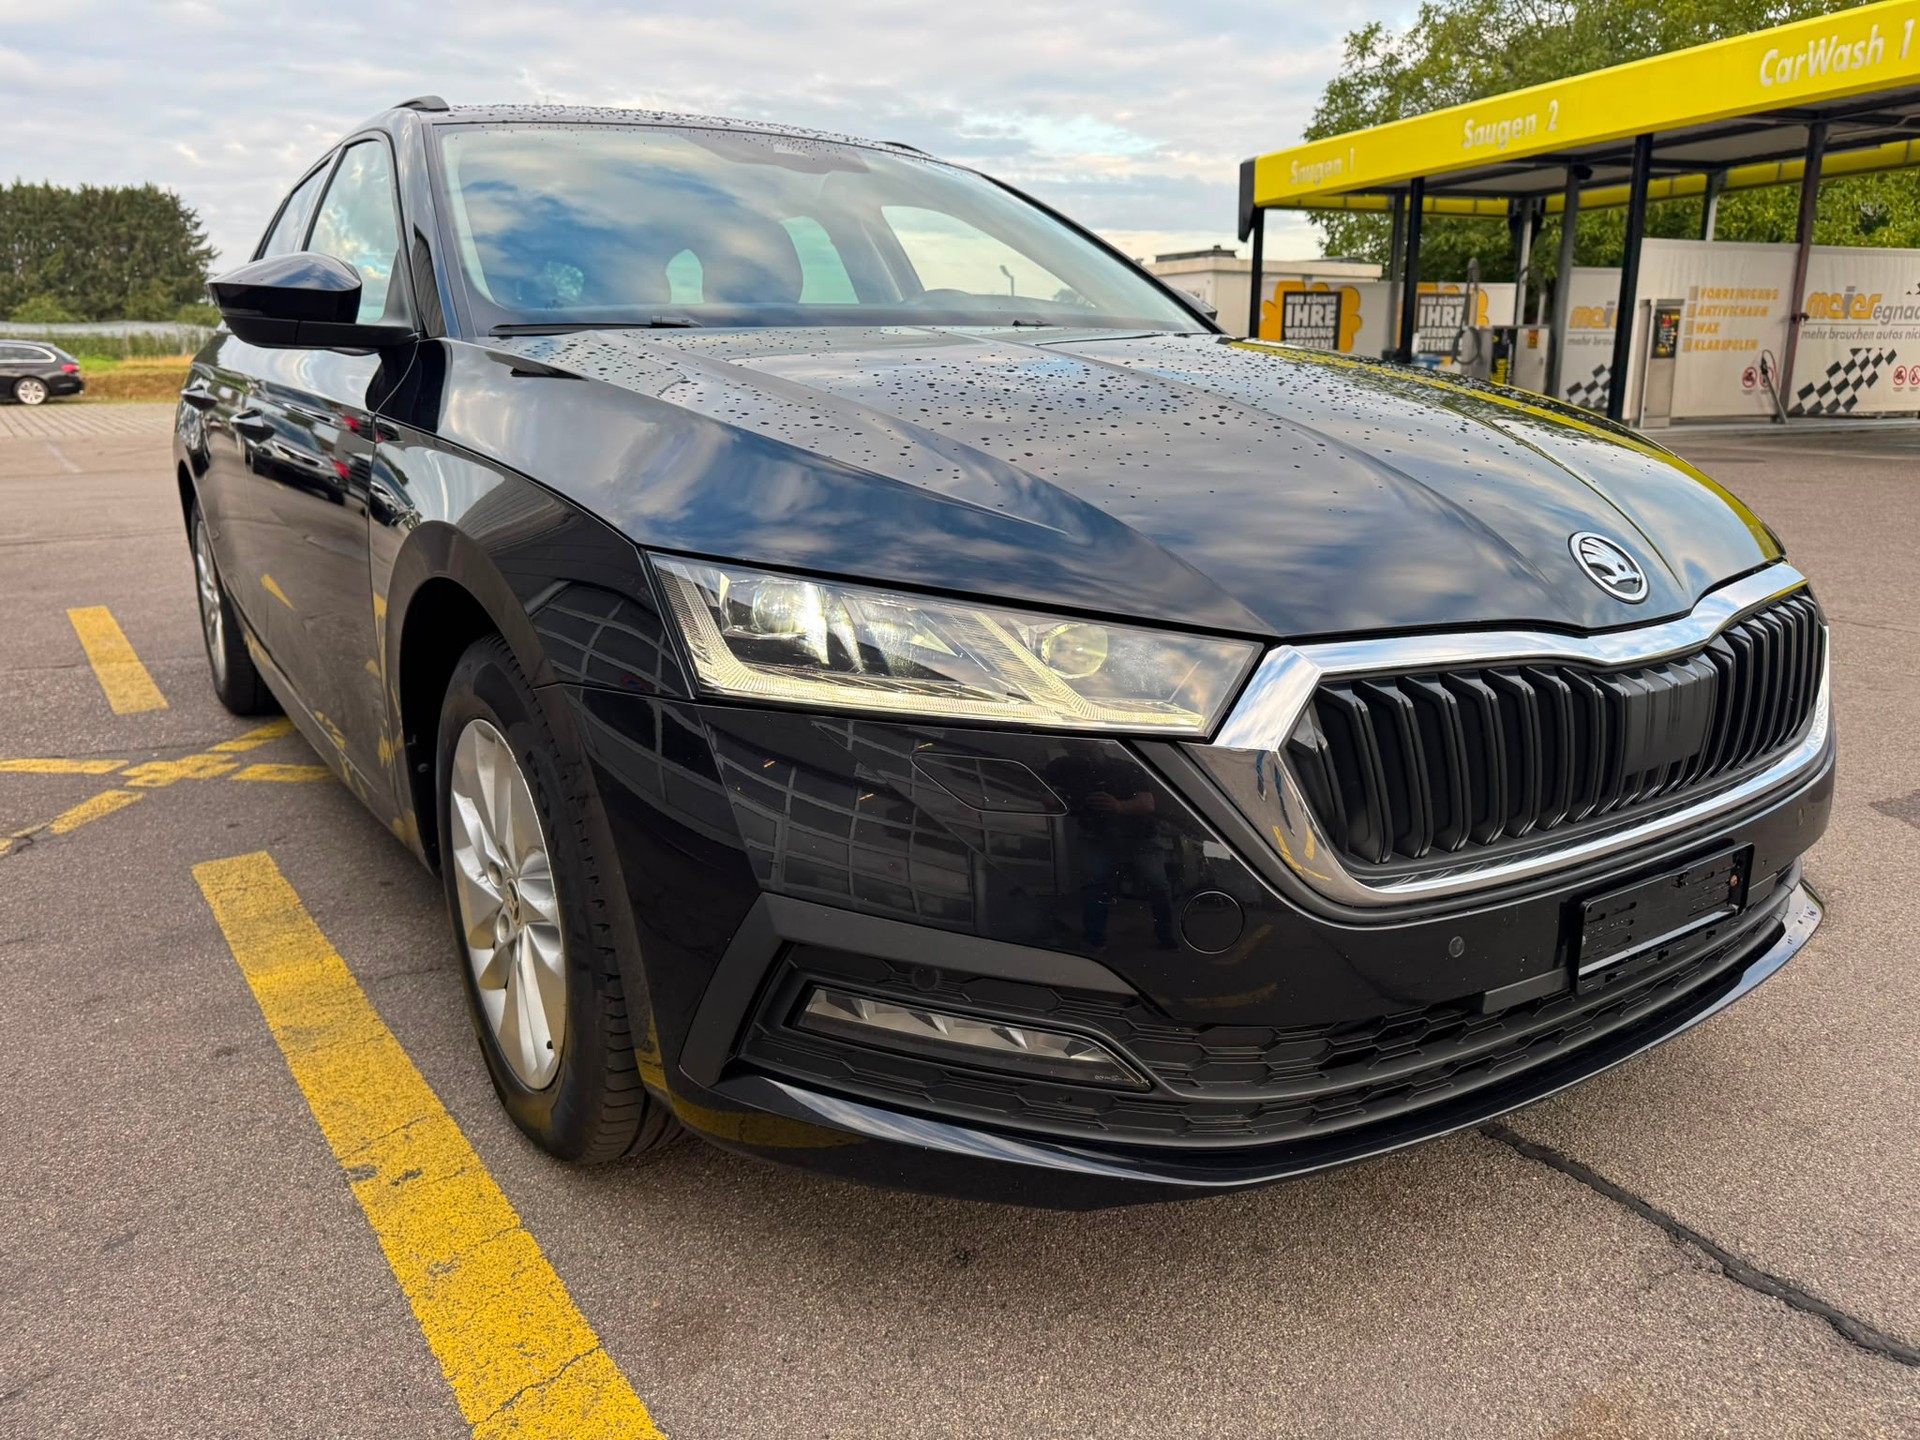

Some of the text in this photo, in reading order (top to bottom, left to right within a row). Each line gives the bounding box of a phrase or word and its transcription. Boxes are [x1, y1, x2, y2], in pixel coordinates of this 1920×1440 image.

[1759, 18, 1915, 88] CarWash 1
[1462, 99, 1559, 150] Saugen 2
[1289, 146, 1355, 187] Saugen 1
[1285, 304, 1337, 327] IHRE
[1284, 327, 1335, 338] WERBUNG
[1800, 327, 1827, 340] mehr
[1828, 326, 1875, 340] brauchen
